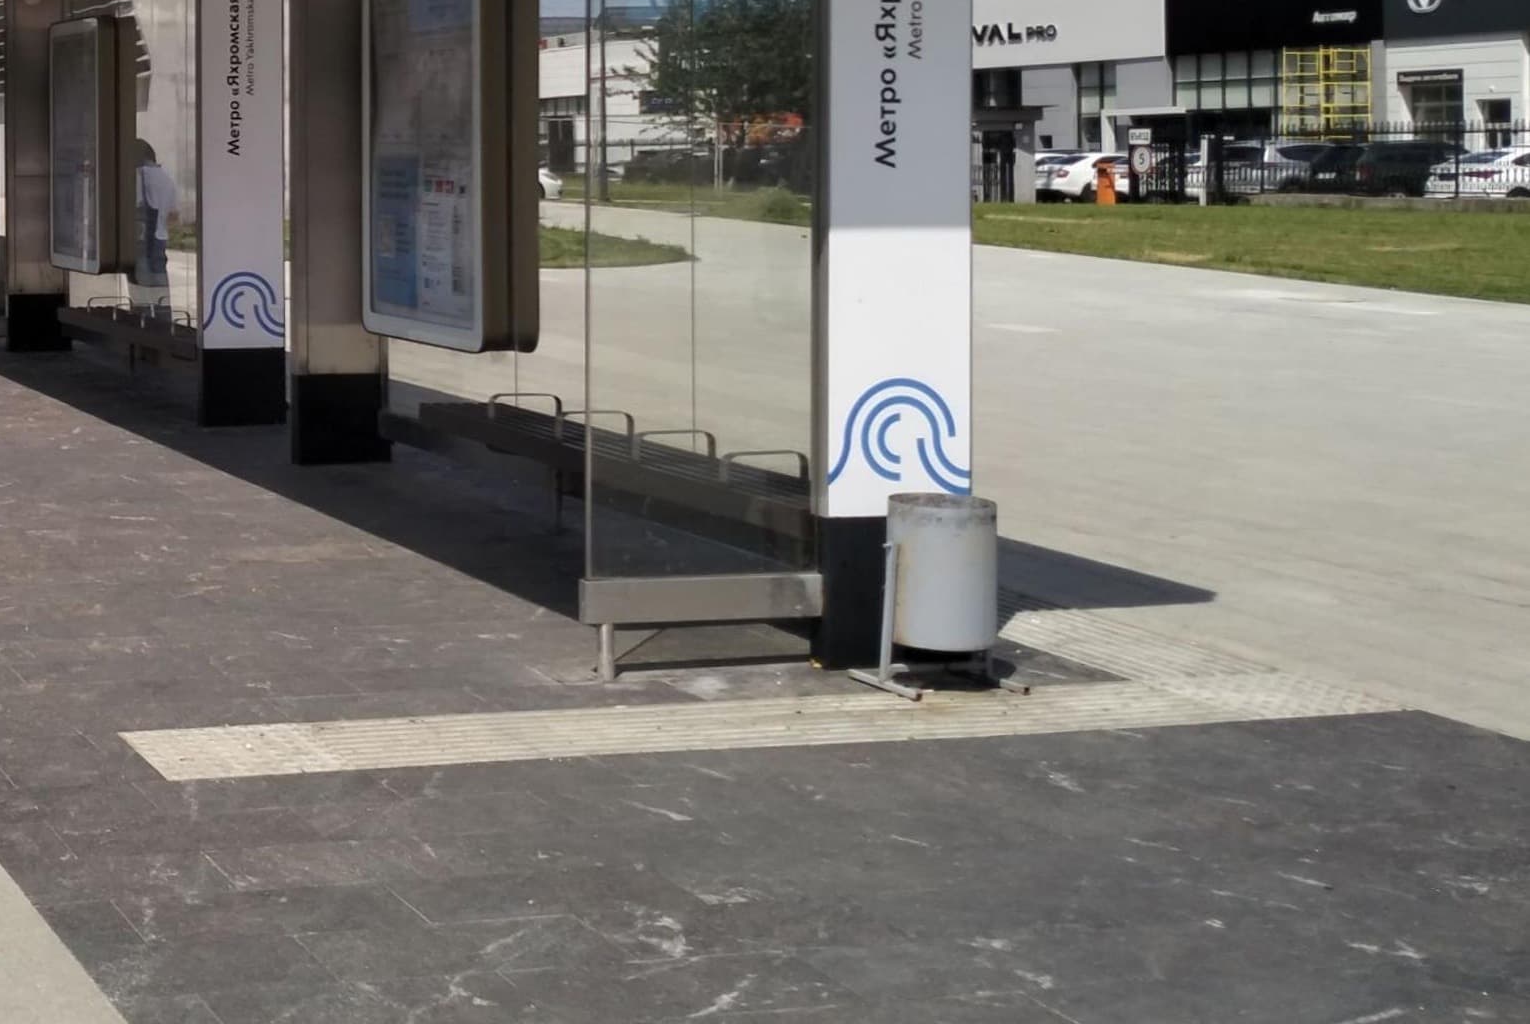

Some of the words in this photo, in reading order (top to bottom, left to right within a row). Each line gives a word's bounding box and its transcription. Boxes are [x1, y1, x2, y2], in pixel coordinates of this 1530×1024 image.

[907, 0, 923, 59] Metro
[1026, 24, 1058, 43] PRO
[245, 63, 255, 96] Metro
[227, 100, 242, 156] Метро
[874, 68, 901, 168] Метро
